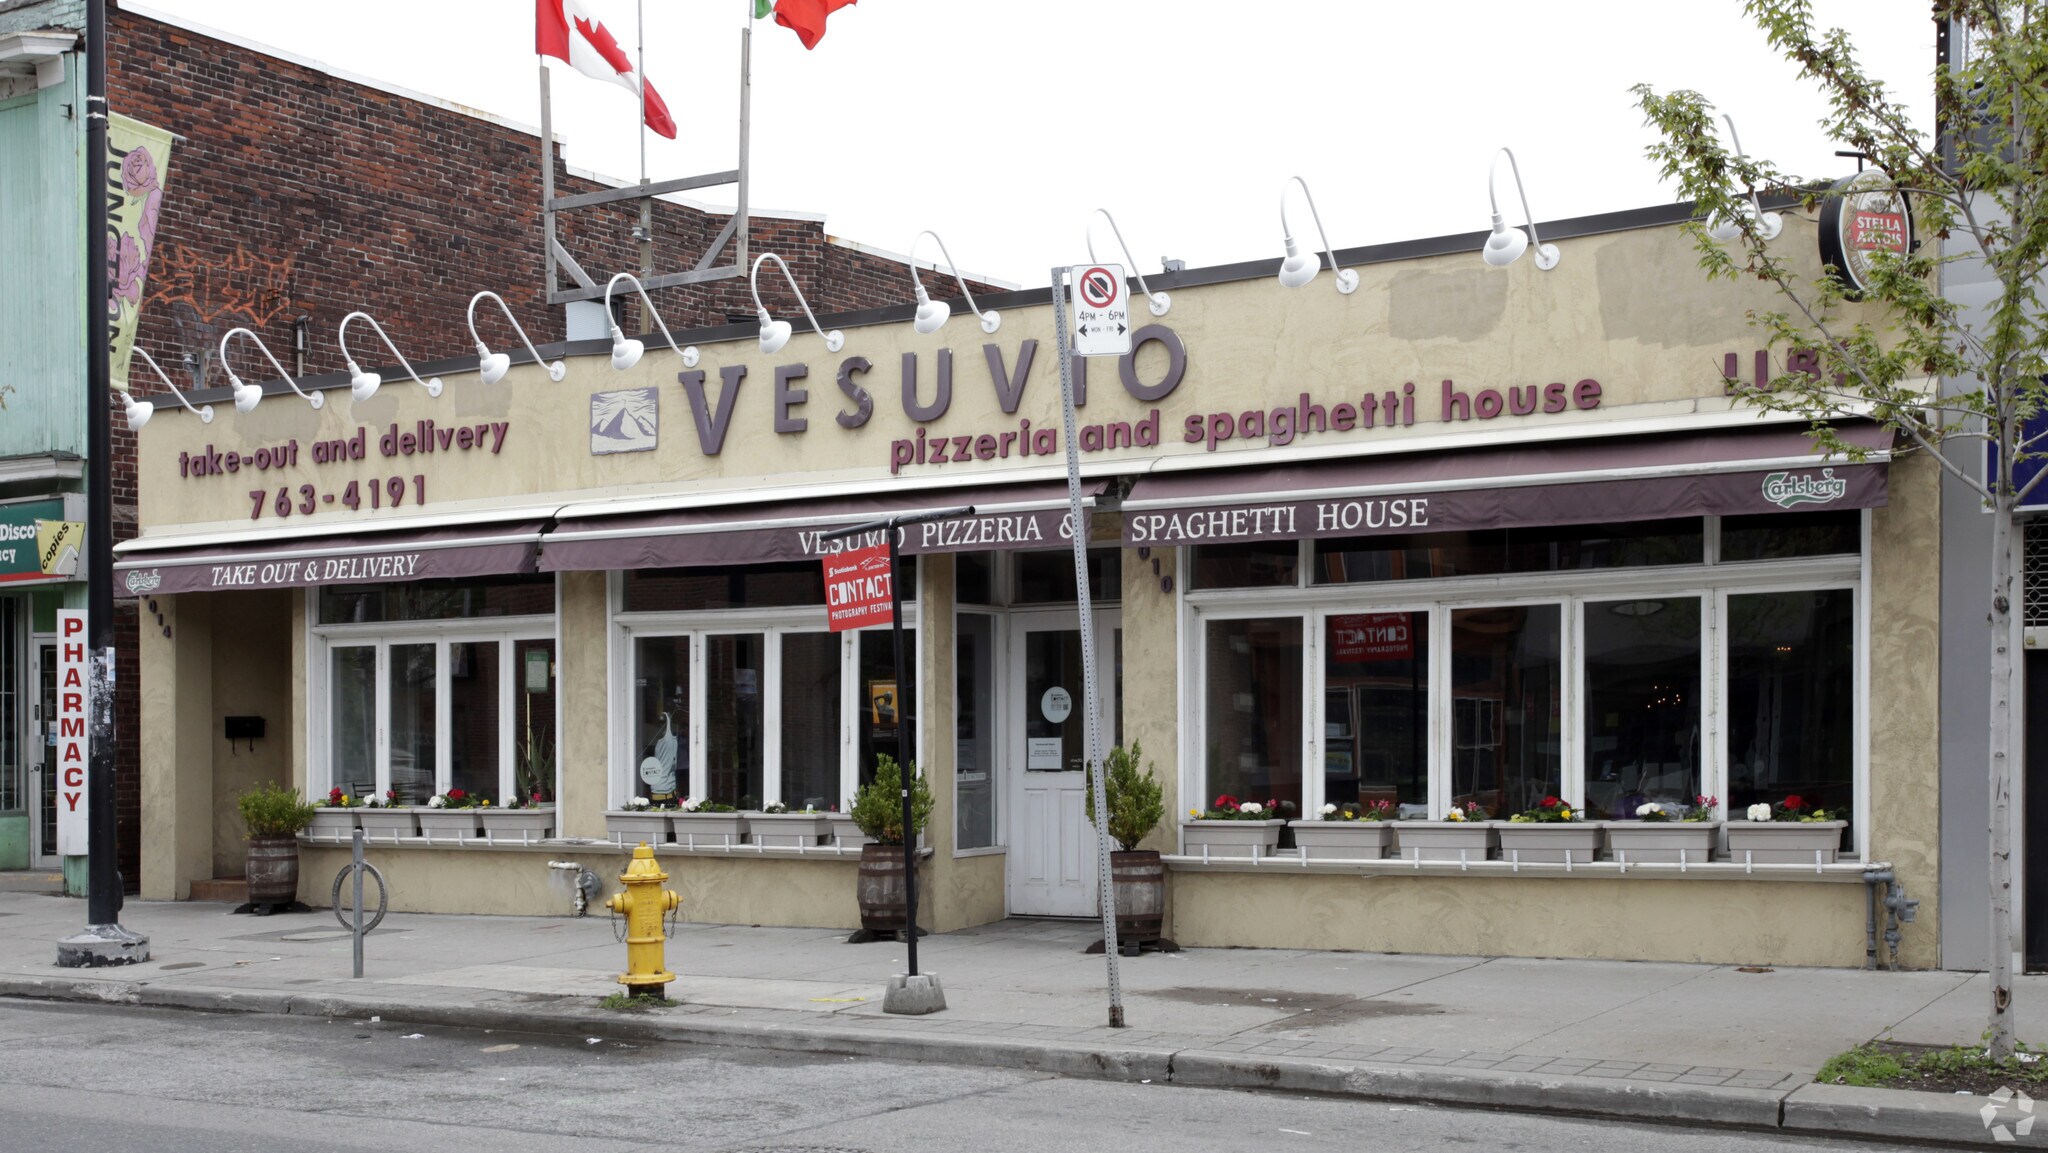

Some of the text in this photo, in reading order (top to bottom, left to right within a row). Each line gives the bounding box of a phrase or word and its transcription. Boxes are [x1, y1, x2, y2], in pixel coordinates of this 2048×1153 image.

[1857, 216, 1901, 232] STELLA
[1079, 310, 1096, 321] 4PM
[1108, 309, 1125, 321] 6PM
[678, 323, 1187, 456] VESUVIO
[179, 419, 509, 477] take-out and delivery
[891, 378, 1601, 474] pizzeria and spaghetti house
[250, 474, 425, 519] 763-4191
[1762, 469, 1846, 508] Carlsberg
[921, 514, 1043, 548] PIZZERIA
[1131, 505, 1296, 541] SPAGHETTI
[1317, 498, 1429, 531] HOUSE
[42, 523, 69, 570] copies
[211, 554, 419, 586] TAKE OUT & DELIVERY
[829, 573, 892, 606] CONTACT
[832, 601, 893, 620] PHOTOGRAPHY FESTIVA
[61, 618, 85, 812] PHARMACY
